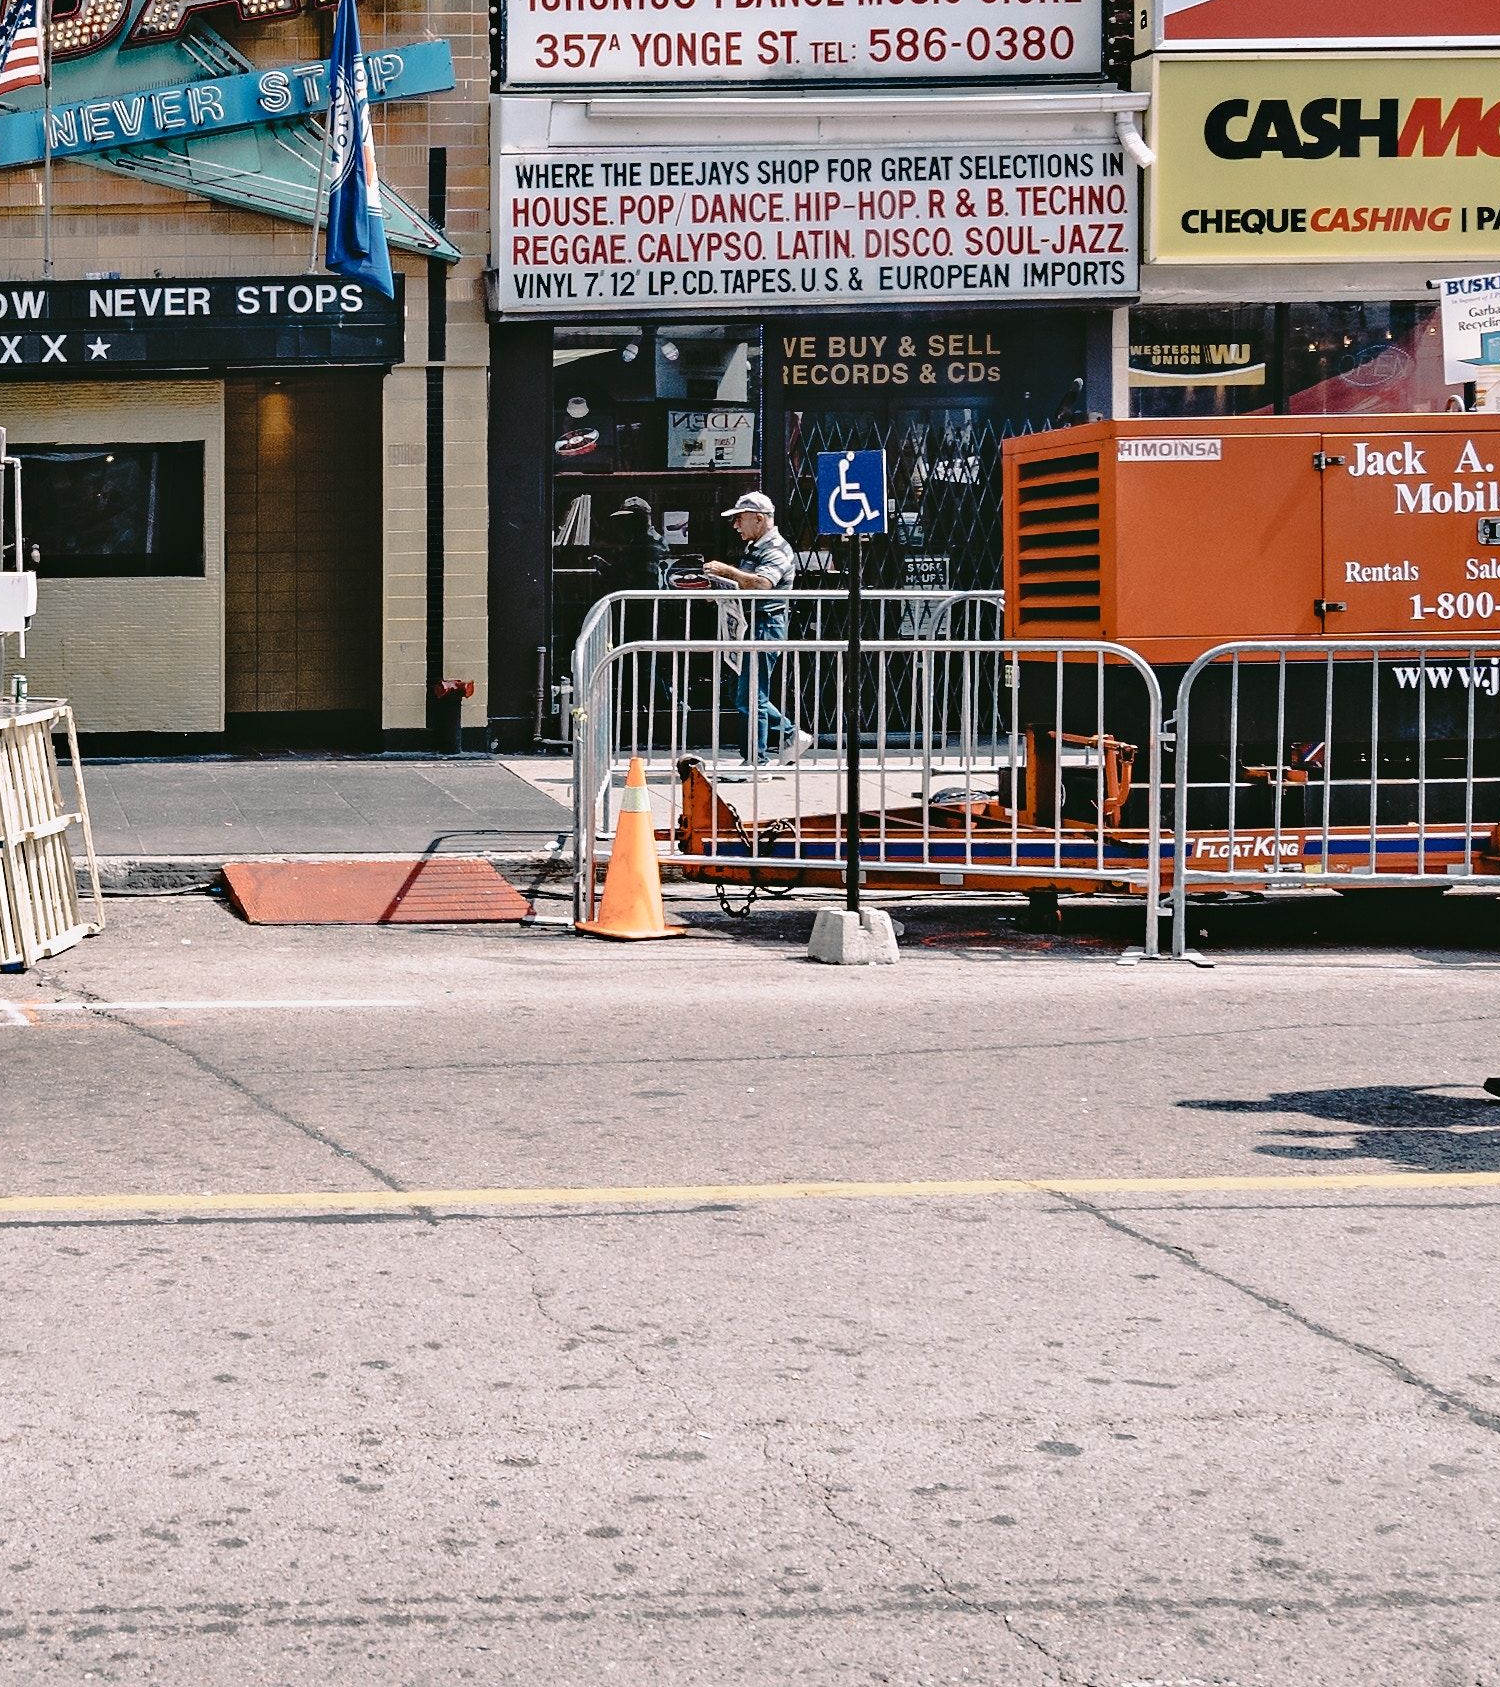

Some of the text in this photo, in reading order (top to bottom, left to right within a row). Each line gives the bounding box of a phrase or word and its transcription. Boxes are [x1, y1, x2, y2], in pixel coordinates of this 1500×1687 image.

[630, 31, 743, 67] YONGE
[757, 30, 801, 66] ST.
[811, 41, 857, 64] TEL:
[868, 25, 1075, 62] 586-0380
[42, 85, 224, 150] NEVER
[259, 52, 405, 114] STP
[514, 152, 1125, 190] WHERE THE DEEJAYS SHOP FOR GREAT SELECTIONS IN
[512, 195, 614, 228] HOUSE.
[794, 190, 921, 224] HIP-HOP.
[928, 189, 946, 219] R
[954, 189, 976, 218] &
[1018, 185, 1129, 216] TECHNO.
[1180, 208, 1308, 235] CHEQUE
[1310, 207, 1451, 233] CASHING
[512, 223, 1130, 266] REGGAE. CALYPSO. LATIN. DISCO. SOUL-JAZZ.
[514, 271, 580, 299] VINYL
[723, 266, 796, 294] TAPES.
[847, 265, 863, 291] &
[878, 262, 1009, 290] EUROPEAN
[1022, 258, 1125, 287] IMPORTS
[89, 286, 212, 320] NEVER
[237, 283, 364, 316] STOPS
[828, 334, 1001, 357] BUY & SELL
[1130, 344, 1200, 355] WESTERN
[1152, 355, 1200, 365] UNION
[919, 362, 1001, 384] & CDs
[1118, 442, 1219, 457] HIMOINSA
[1349, 441, 1428, 477] Jack
[1455, 439, 1494, 473] A.
[1345, 560, 1420, 583] Rentals
